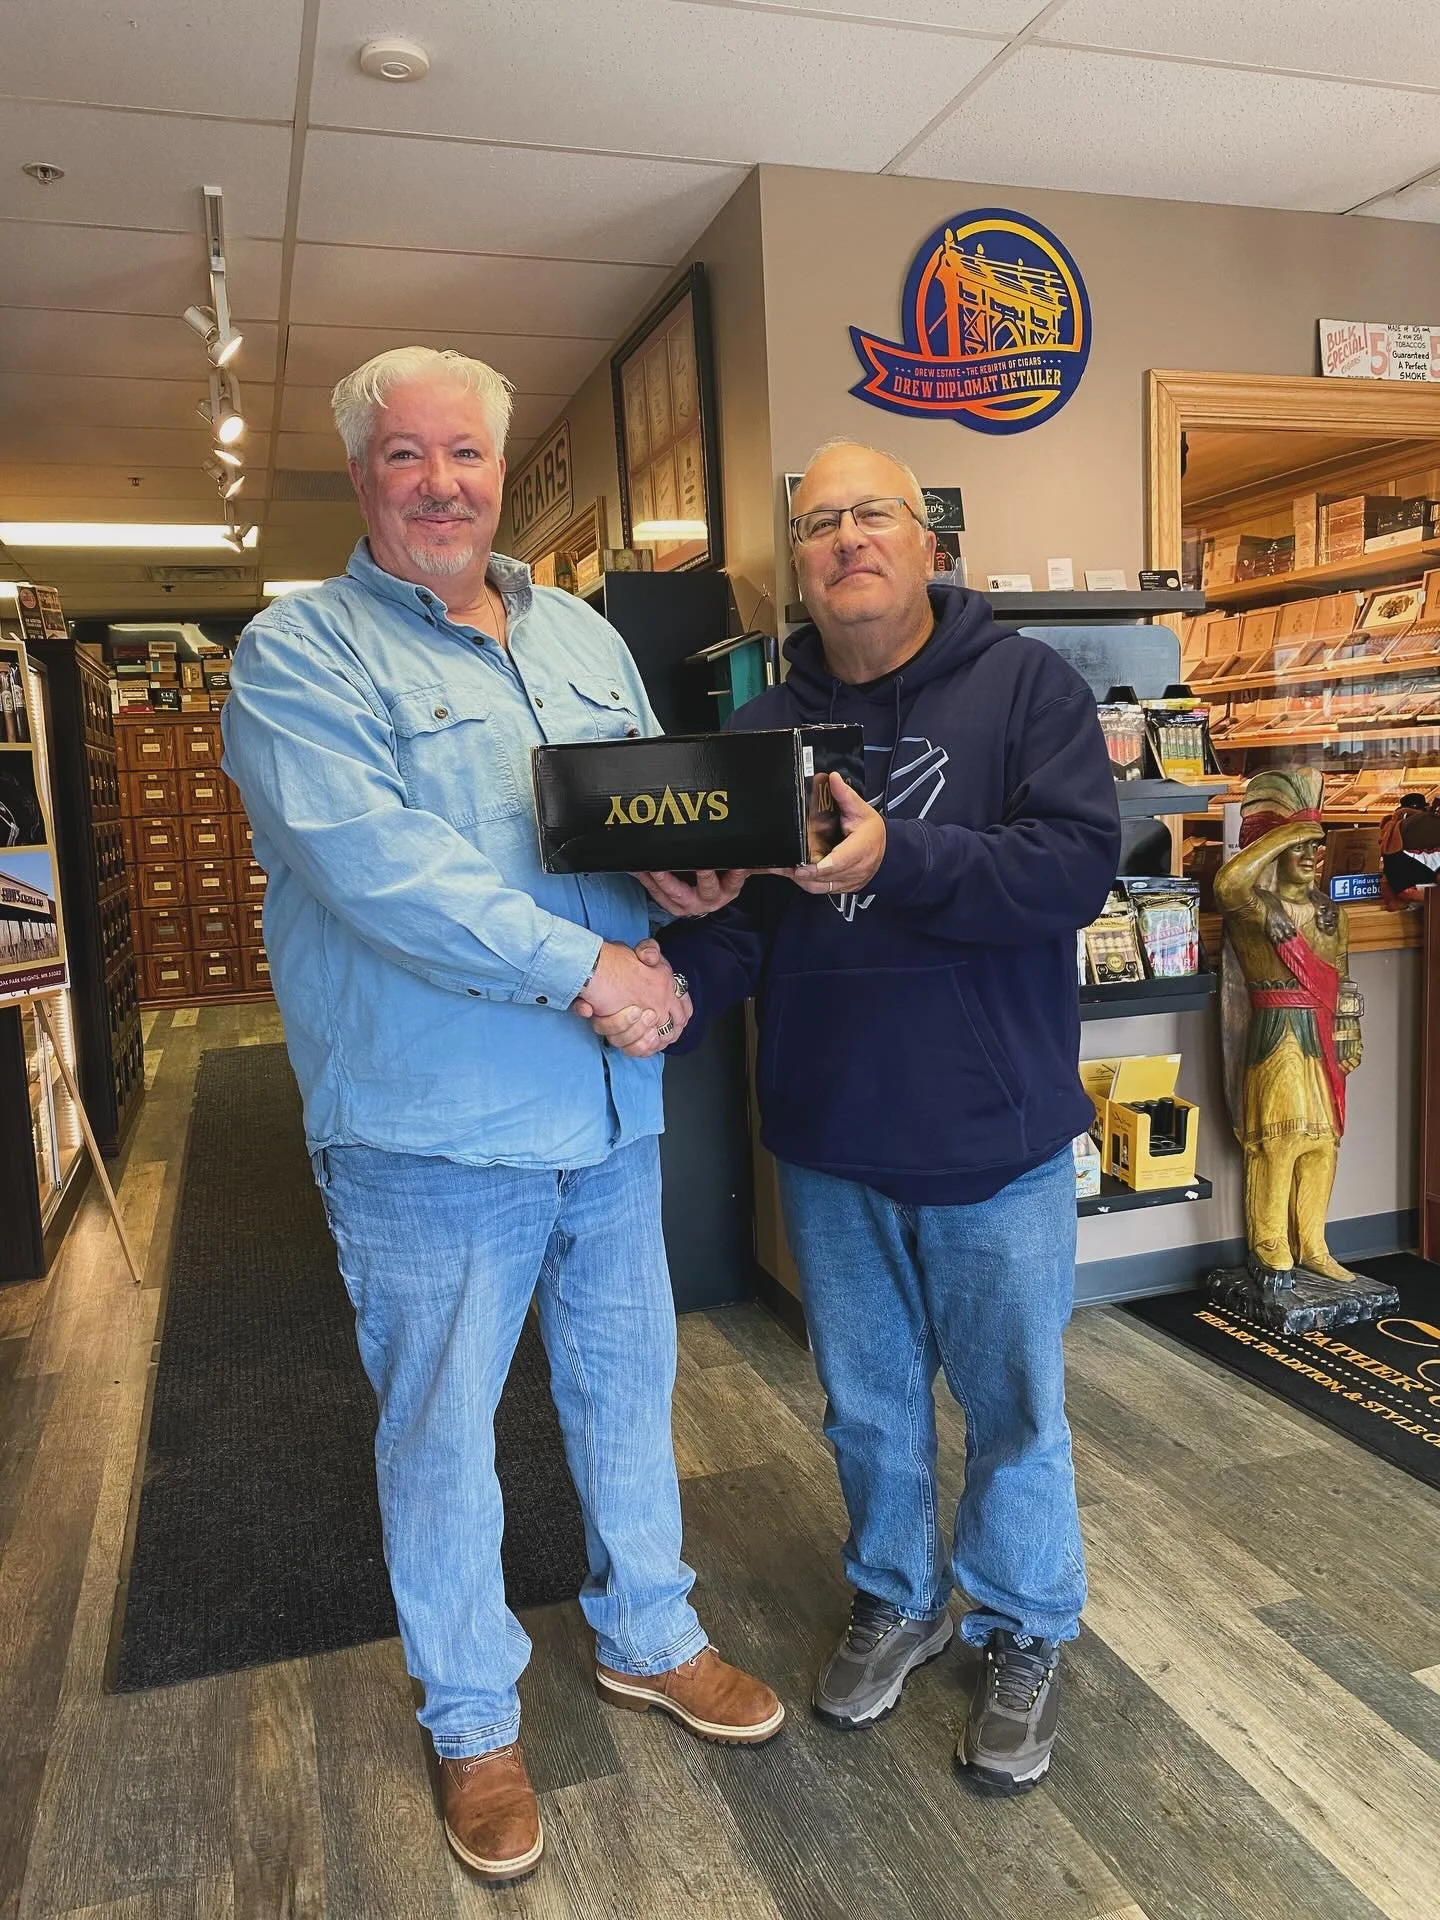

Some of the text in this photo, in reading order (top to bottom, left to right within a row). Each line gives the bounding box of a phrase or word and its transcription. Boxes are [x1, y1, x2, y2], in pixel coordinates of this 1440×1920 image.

[1327, 326, 1356, 352] BULK
[1395, 341, 1426, 349] TOBACCOS
[1392, 350, 1430, 360] Guaranteed
[914, 356, 1042, 378] DREW ESTATE THE REBIRTH OF CIGARS
[1398, 361, 1428, 371] A Perfect
[1399, 372, 1427, 381] SMOKE
[893, 368, 1062, 399] DREW DIPLOMAT RETAILER
[511, 437, 568, 537] CIGARS
[925, 503, 945, 514] ED'S
[605, 784, 729, 826] SAVOY
[1352, 884, 1381, 896] faceb
[9, 977, 20, 985] PARK
[1192, 1310, 1230, 1328] THE
[1342, 1392, 1363, 1402] &
[1359, 1400, 1429, 1435] STYLE
